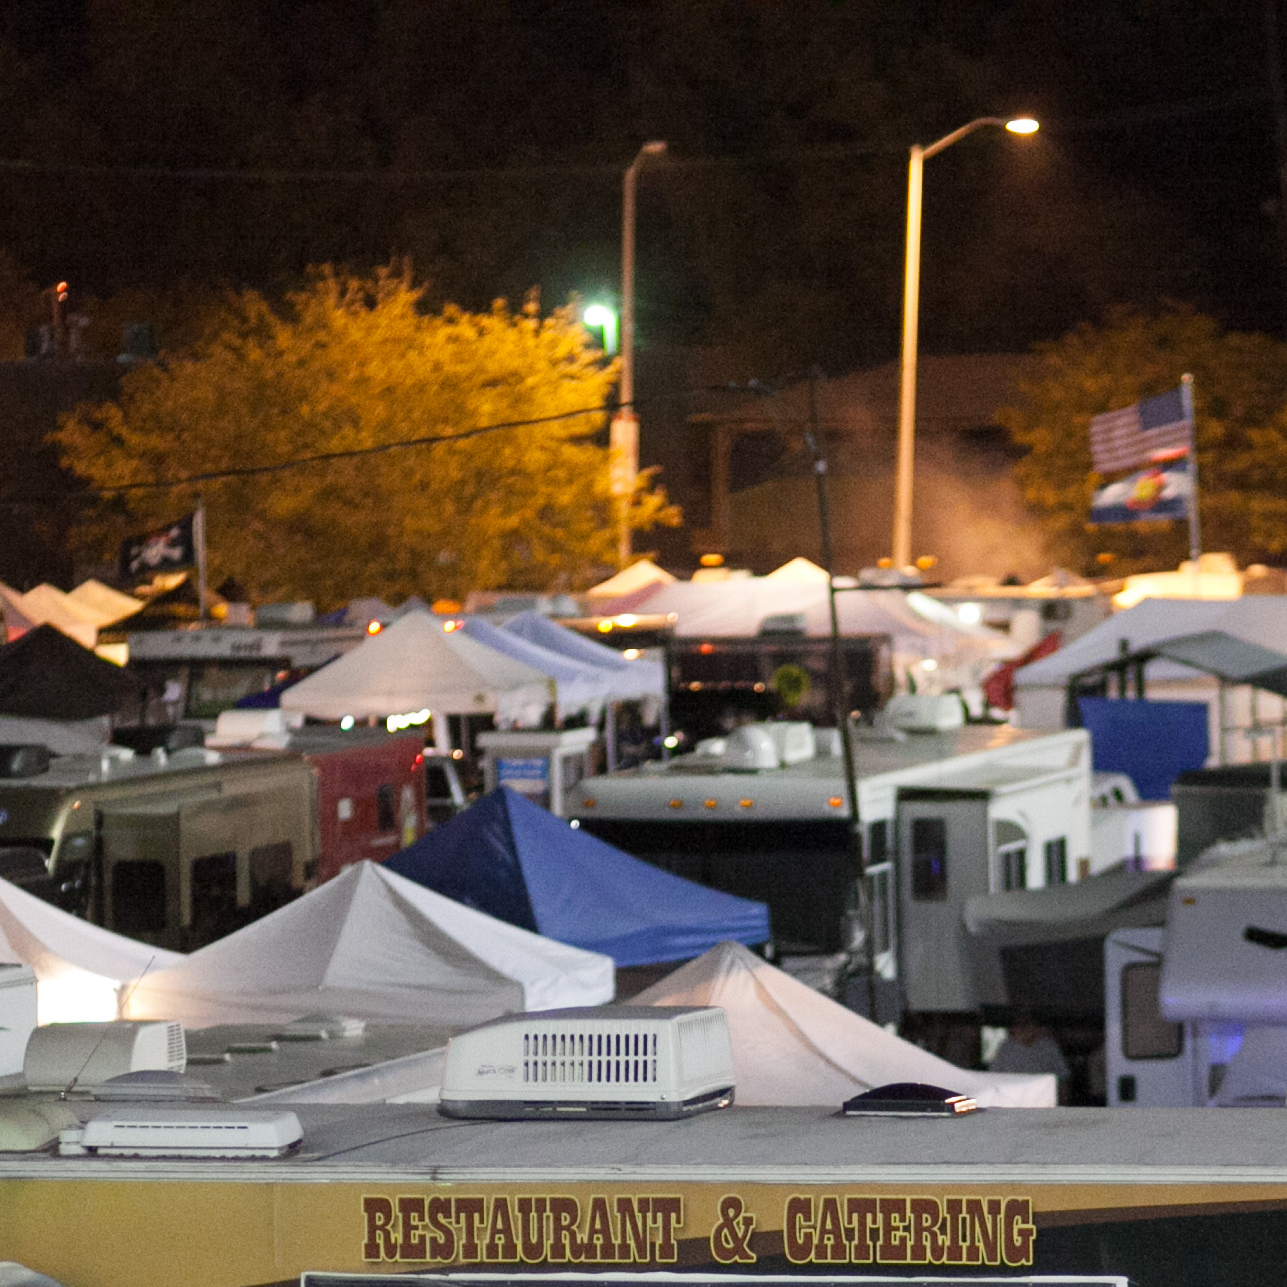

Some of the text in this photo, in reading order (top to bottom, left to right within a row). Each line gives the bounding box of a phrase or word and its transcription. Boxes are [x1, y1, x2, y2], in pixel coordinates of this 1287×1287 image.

[361, 1193, 1037, 1266] RESTAURANT & CATERING
